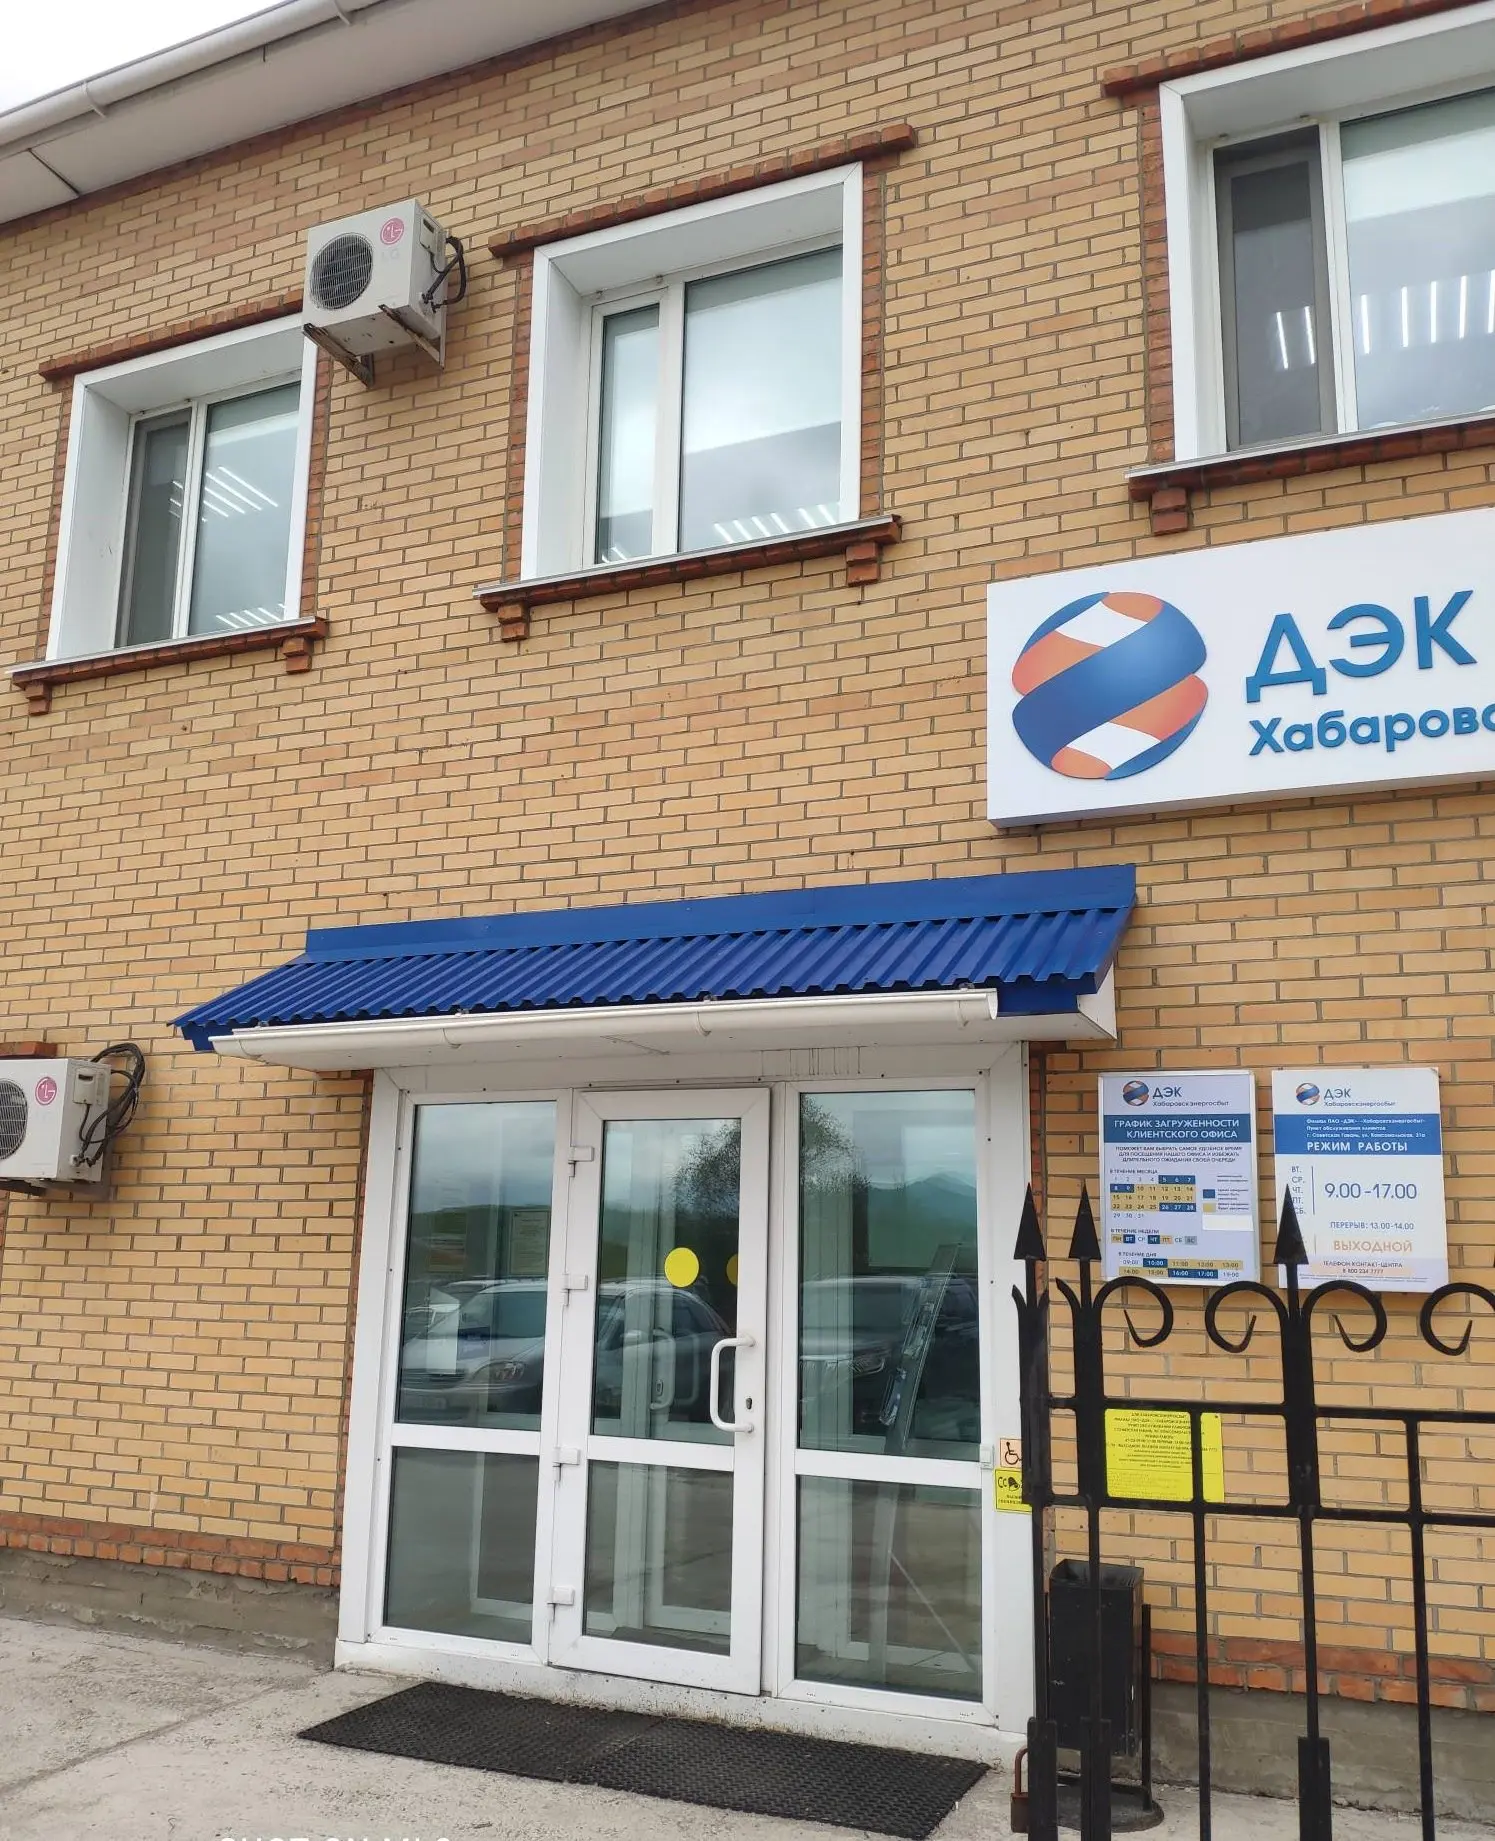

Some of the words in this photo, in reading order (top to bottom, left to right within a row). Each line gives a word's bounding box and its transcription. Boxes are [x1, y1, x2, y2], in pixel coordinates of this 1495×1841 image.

[1246, 590, 1477, 702] ДЭК
[1152, 1086, 1182, 1099] ДЭК
[1324, 1088, 1352, 1100] ДЭК
[1114, 1120, 1153, 1128] ГРАФИК
[1154, 1120, 1240, 1128] ЗАГРУЖЕННОСТИ
[1126, 1130, 1198, 1139] КЛИЕНТСКОГО
[1200, 1130, 1238, 1139] ОФИСА
[1306, 1142, 1350, 1151] РЕЖИМ
[1358, 1142, 1408, 1151] РАБОТЫ
[1334, 1240, 1412, 1253] ВЫХОДНОЙ
